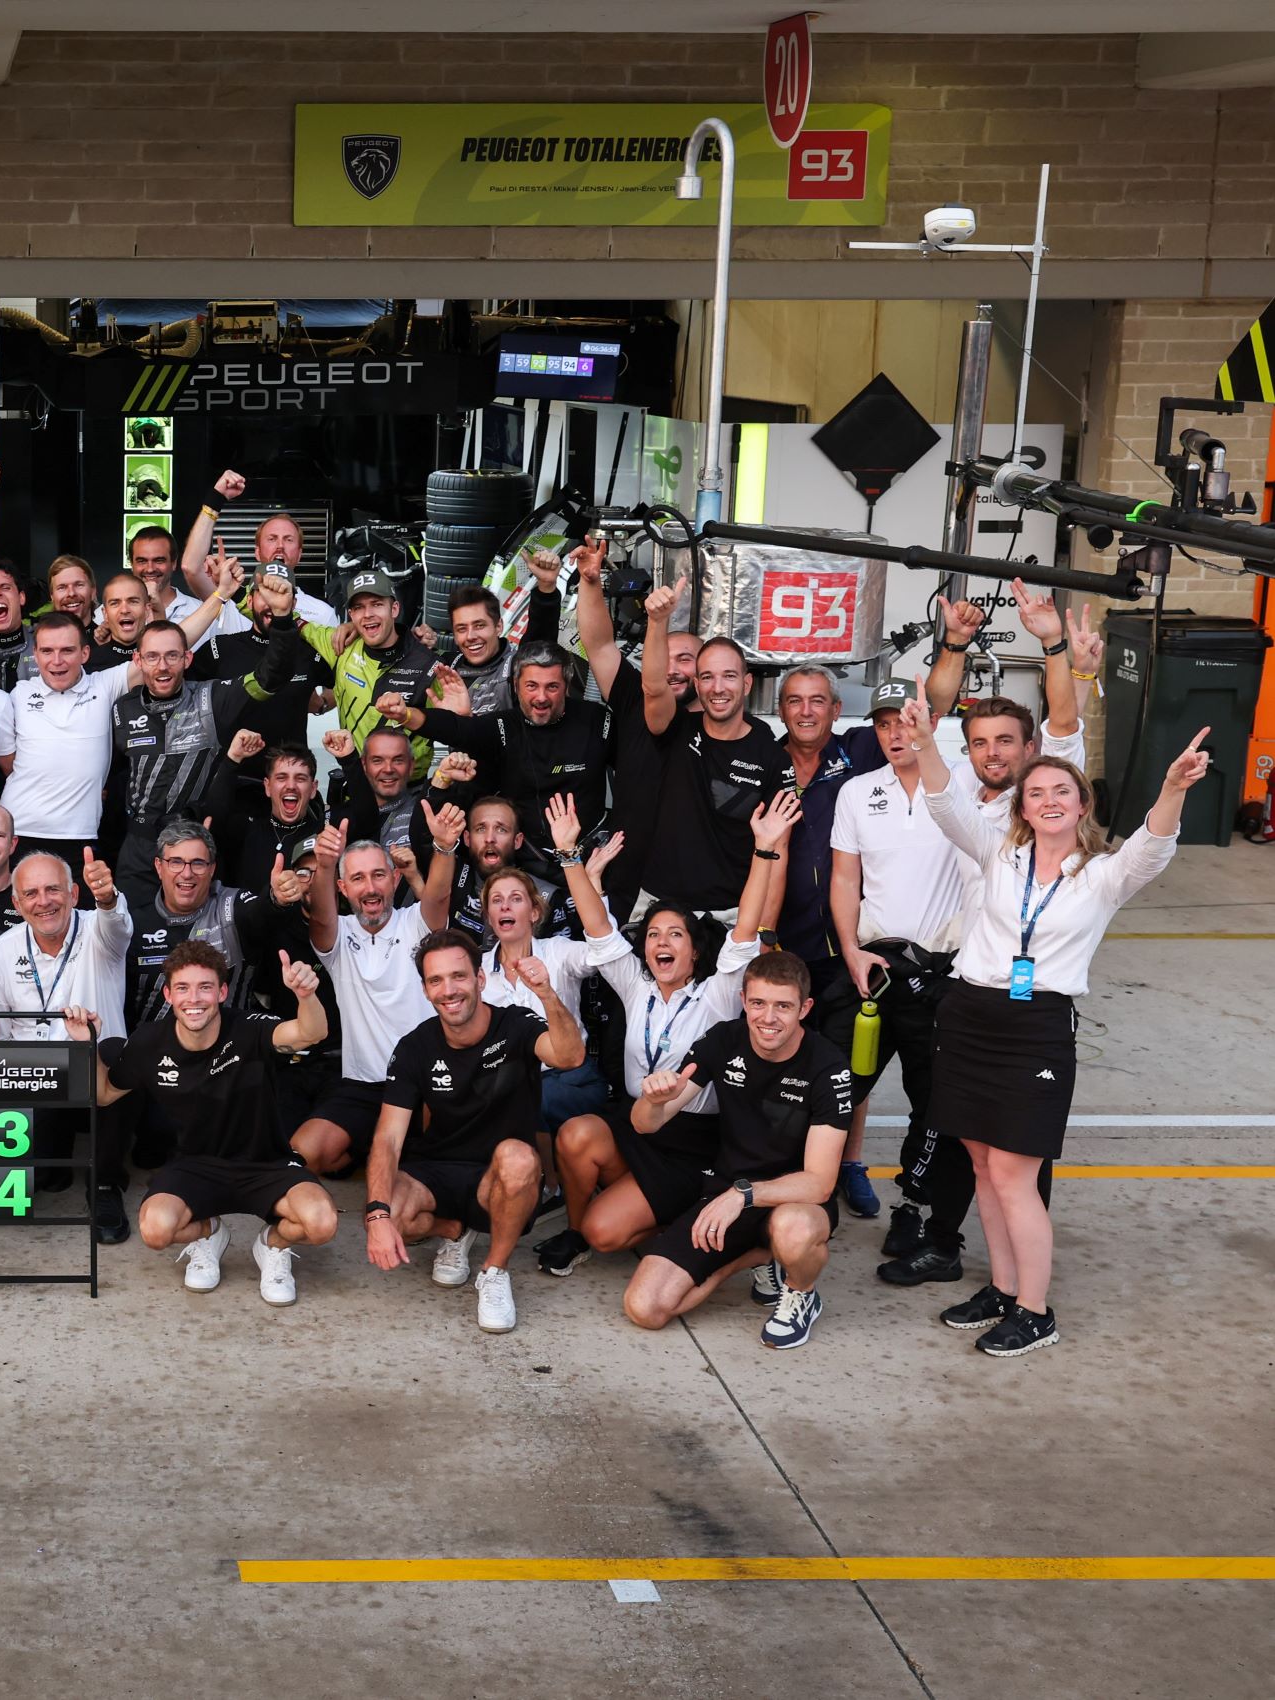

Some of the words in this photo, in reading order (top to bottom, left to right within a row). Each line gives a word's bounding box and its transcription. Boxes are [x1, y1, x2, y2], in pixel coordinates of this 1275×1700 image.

[775, 32, 799, 117] 20
[347, 140, 396, 148] PEUGEOT
[461, 137, 560, 163] PEUGEOT
[801, 149, 854, 182] 93
[504, 358, 510, 366] 5
[517, 358, 529, 366] 59
[532, 360, 545, 368] 93
[548, 360, 560, 369] 95
[564, 361, 576, 369] 94
[581, 362, 588, 371] 6
[190, 362, 423, 386] PEUGEOT
[173, 388, 337, 411] SPORT
[266, 564, 289, 578] 93
[353, 574, 376, 590] 93
[770, 579, 847, 639] 93
[879, 683, 907, 701] 93
[1256, 755, 1274, 779] 59
[729, 772, 755, 786] Capgemini
[209, 1058, 235, 1076] Capgemini
